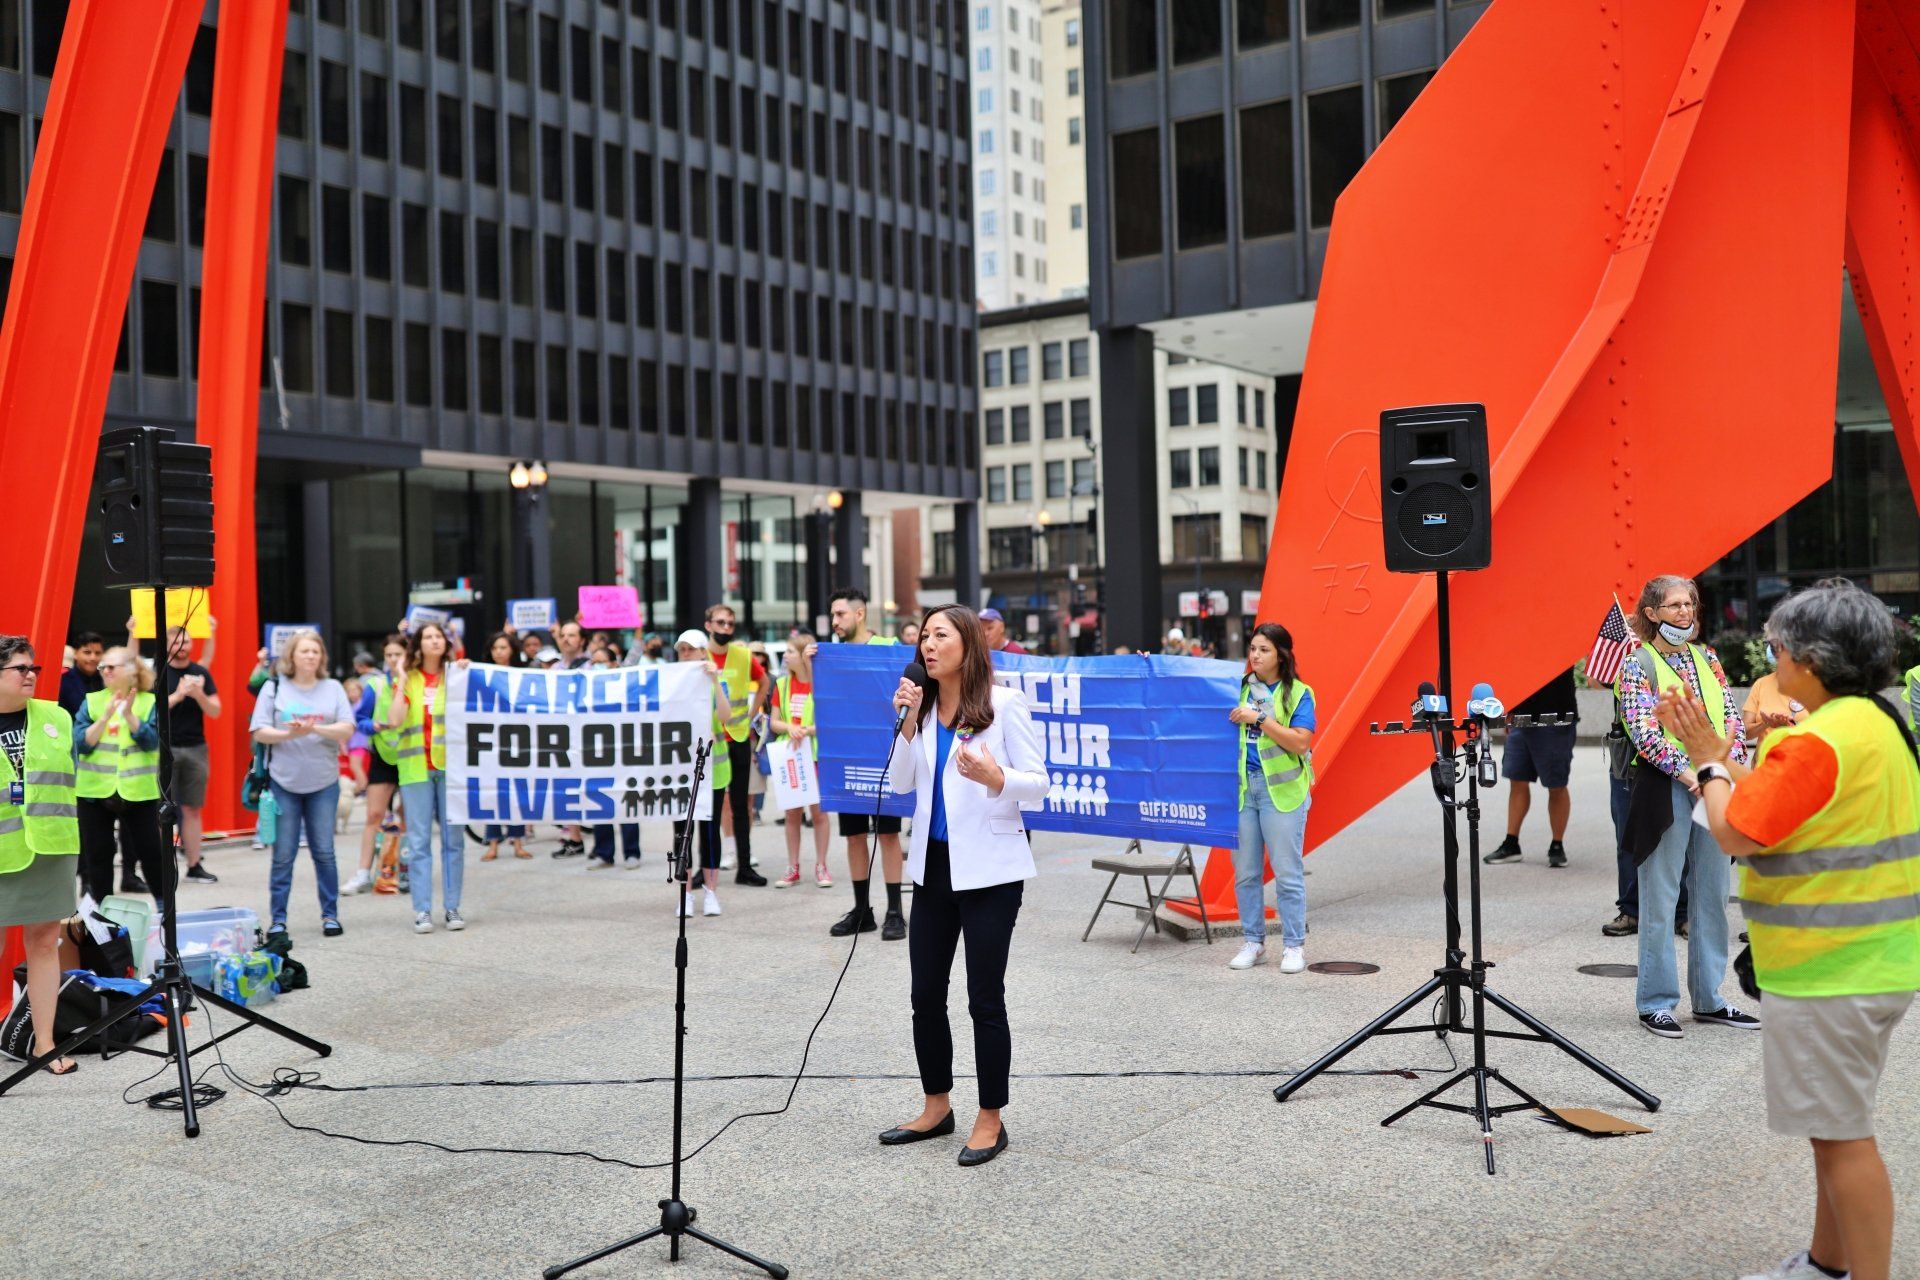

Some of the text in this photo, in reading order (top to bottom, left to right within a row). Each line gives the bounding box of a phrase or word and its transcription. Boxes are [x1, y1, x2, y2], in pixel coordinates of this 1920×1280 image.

[1311, 561, 1373, 615] 73
[464, 668, 660, 714] MARCH
[1429, 694, 1441, 712] 9
[1470, 702, 1485, 710] abc
[466, 721, 692, 768] FOR OUR
[466, 777, 616, 821] LIVES
[844, 781, 896, 794] EVERYTOW
[1139, 801, 1207, 820] GIFFORDS
